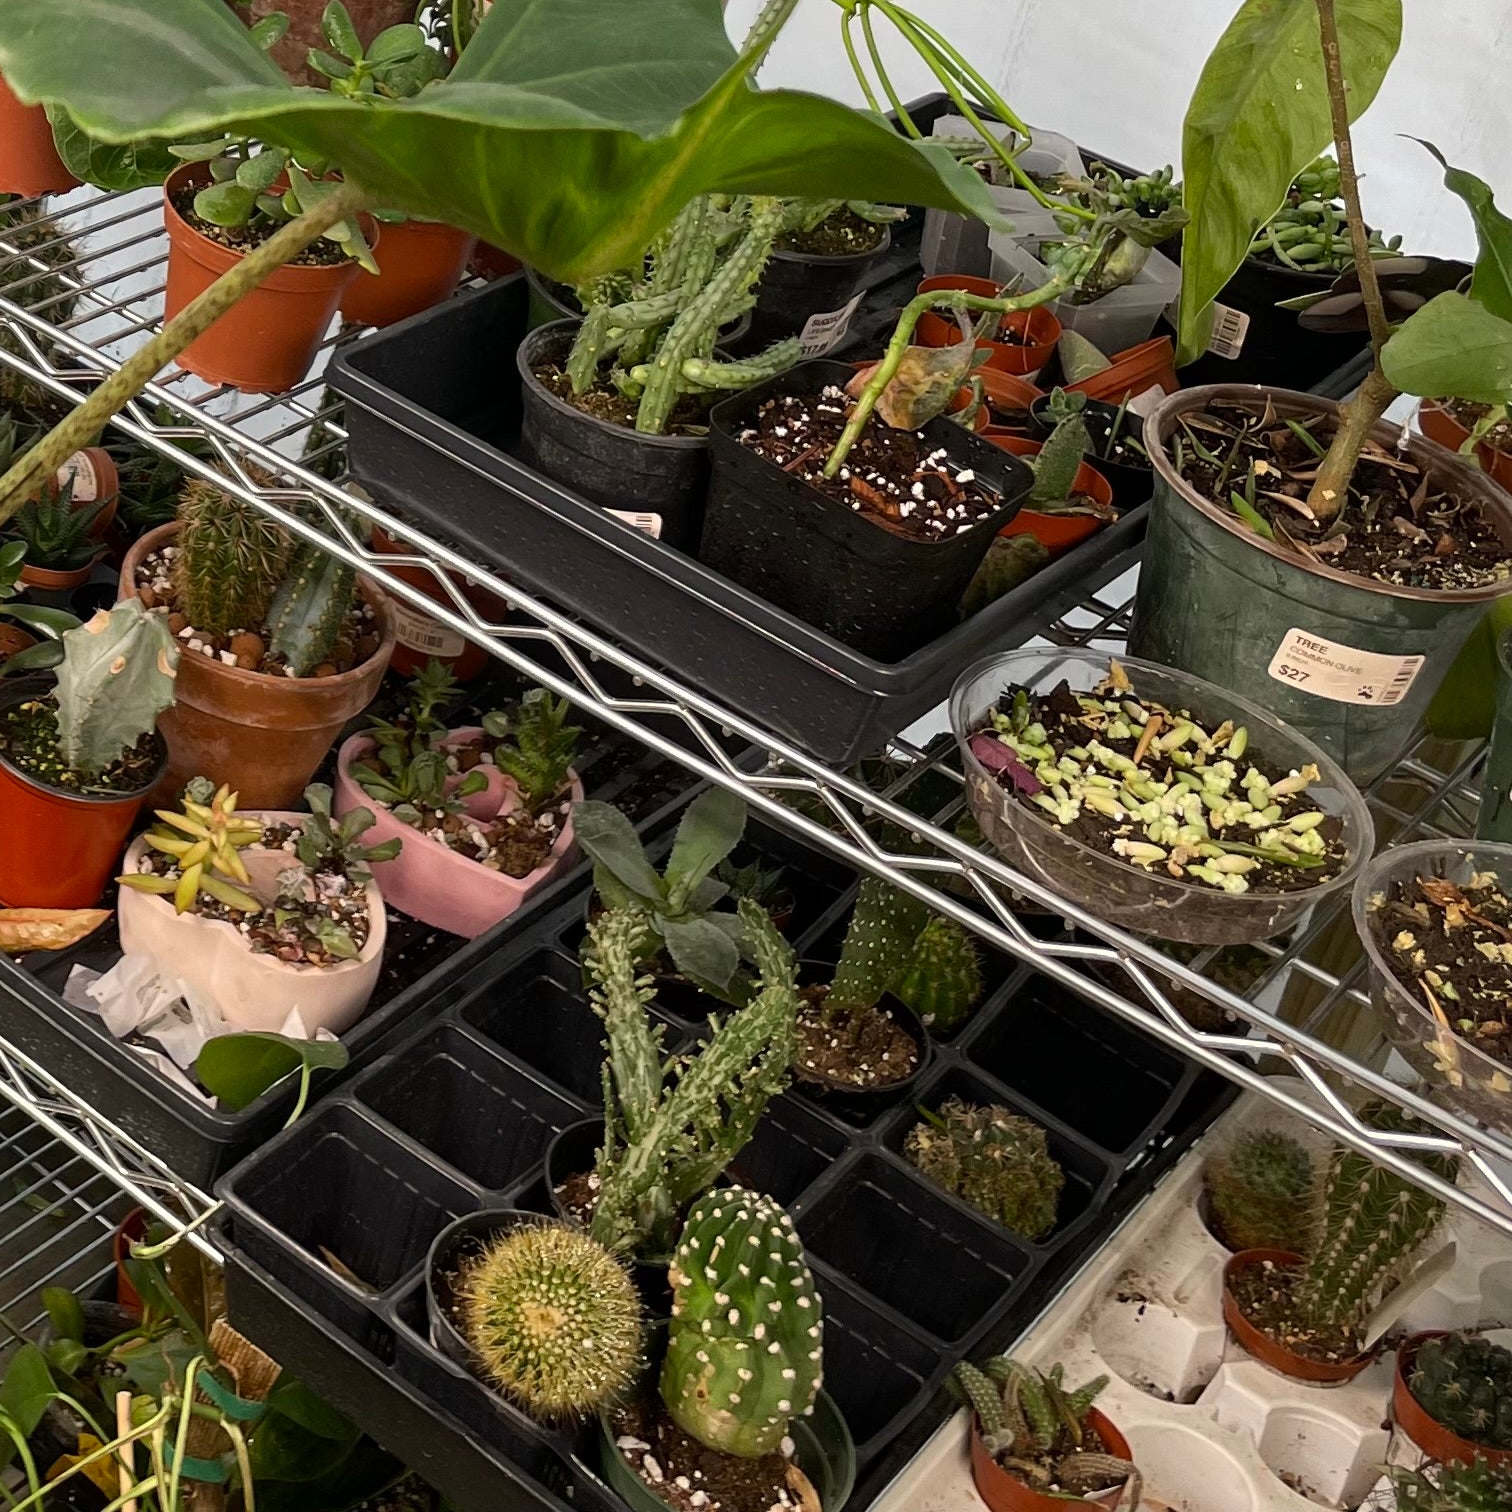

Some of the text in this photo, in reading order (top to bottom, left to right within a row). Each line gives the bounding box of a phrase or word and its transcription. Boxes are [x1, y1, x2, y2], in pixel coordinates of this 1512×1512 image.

[1295, 635, 1329, 655] TREE
[1289, 645, 1364, 675] COMMON OLIVE
[1278, 664, 1311, 683] $27
